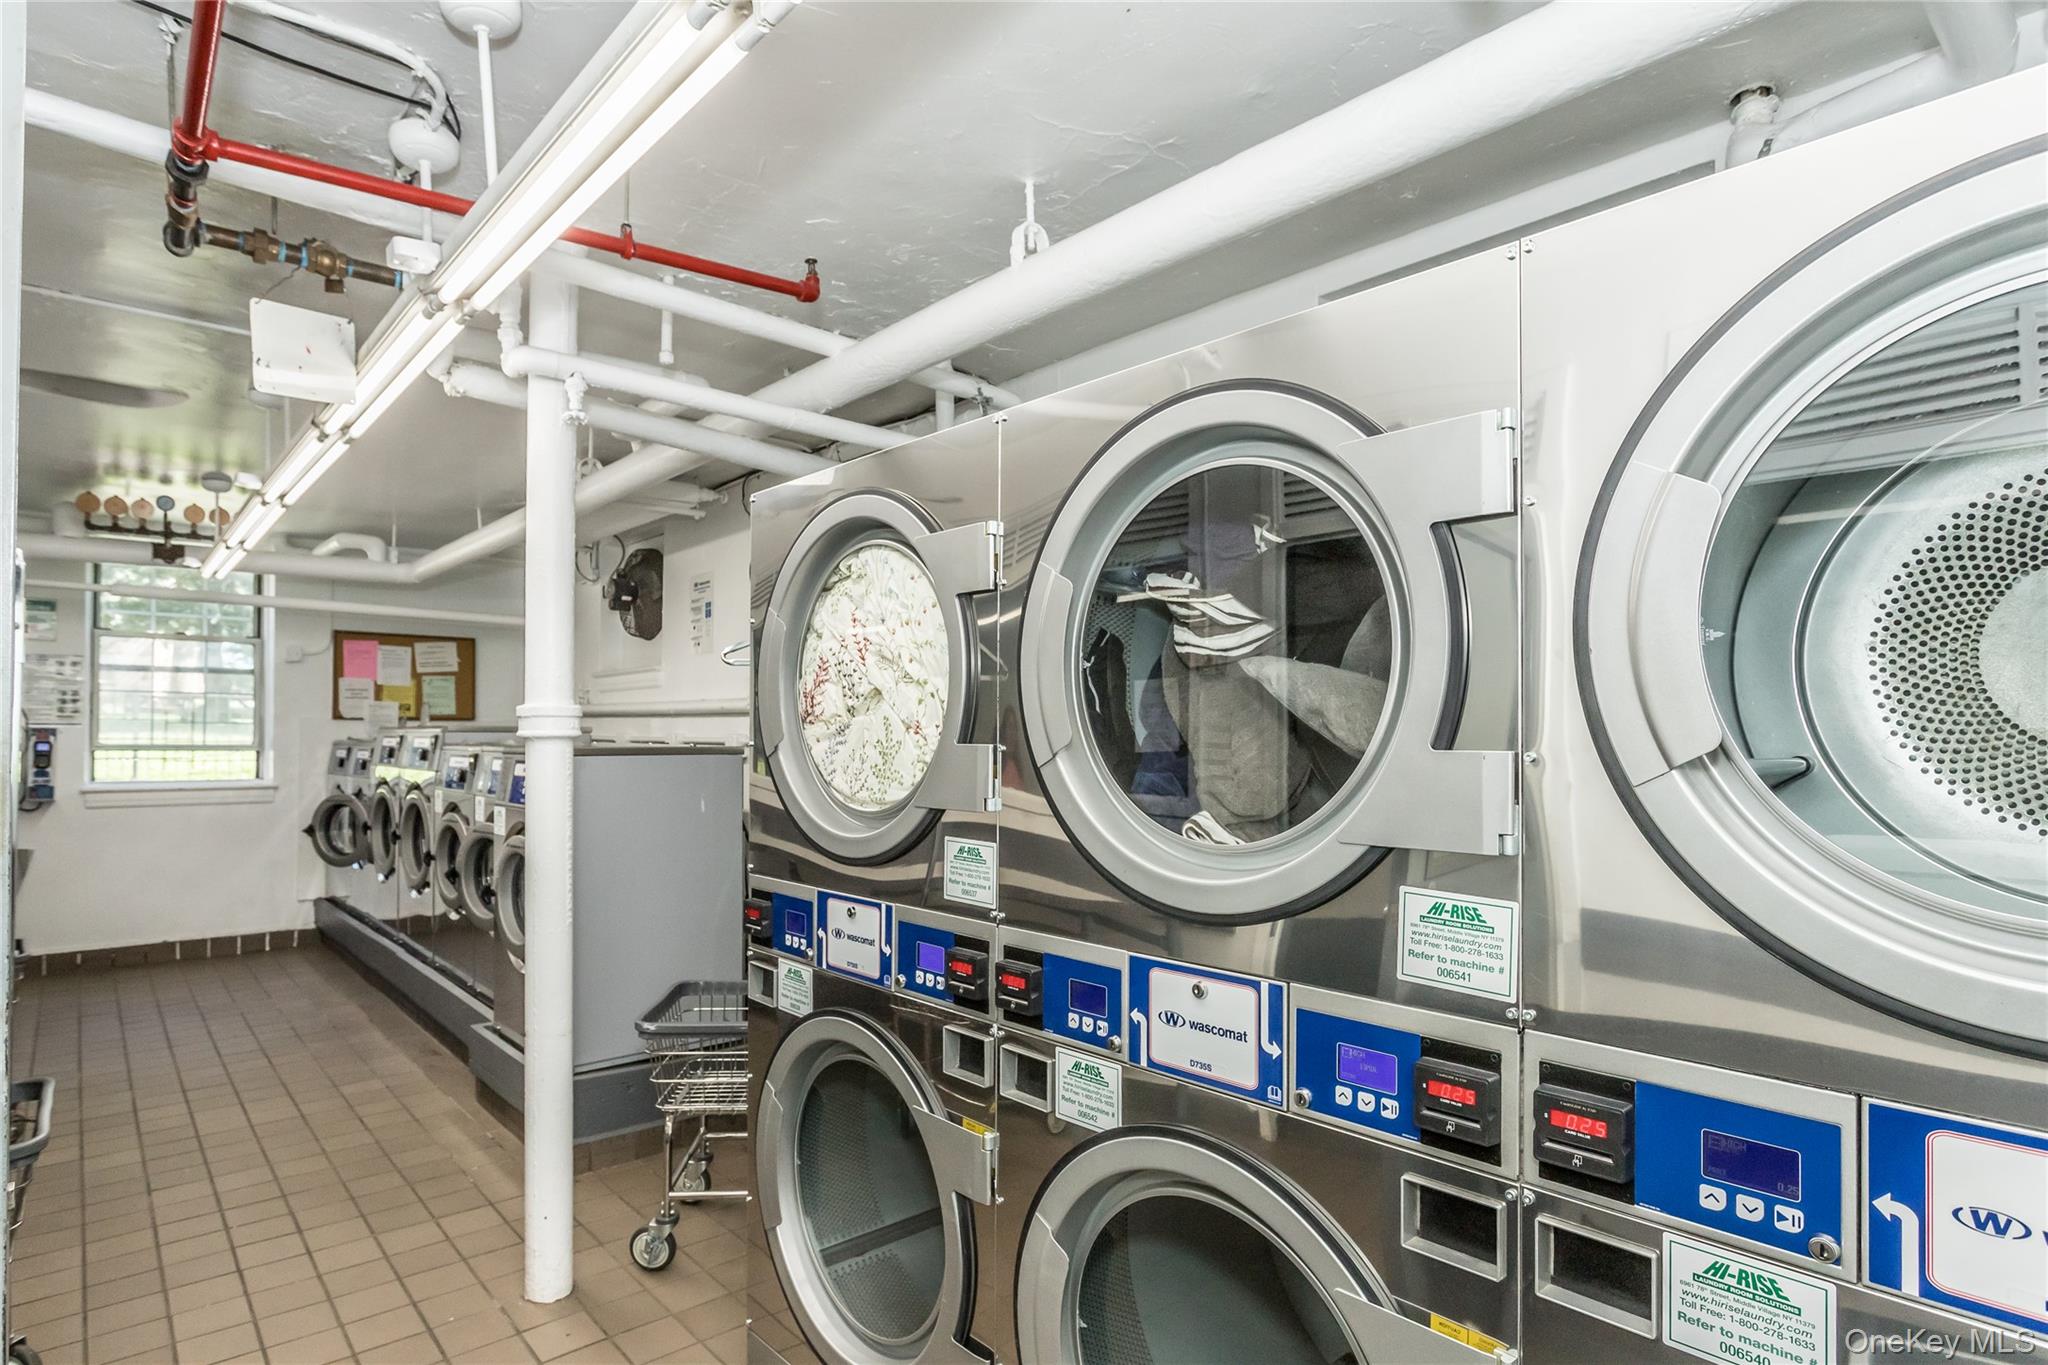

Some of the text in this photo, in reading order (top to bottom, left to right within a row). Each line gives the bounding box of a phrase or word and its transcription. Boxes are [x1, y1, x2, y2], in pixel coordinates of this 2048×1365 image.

[1427, 902, 1488, 924] HI-RISE
[846, 933, 876, 947] wascomat
[1411, 930, 1502, 950] www.hiriselaundry.com
[1424, 940, 1442, 949] Free:
[1444, 944, 1504, 960] 1-800-278-1633
[1408, 948, 1504, 974] Refer to machine #
[1436, 967, 1472, 982] 006541
[1188, 1020, 1248, 1042] wascomat
[1072, 1060, 1104, 1079] HI-RISE
[1190, 1060, 1212, 1072] D735S
[1777, 1182, 1800, 1196] 0.25
[1702, 1260, 1791, 1302] HI-RISE
[1694, 1274, 1799, 1314] LAUNDRY ROOM SOLUTIONS
[1680, 1297, 1816, 1351] Toll Free: 1-800-278-1633
[1682, 1288, 1812, 1338] www.hiriselaundry.com
[1733, 1296, 1755, 1308] Middle
[1758, 1304, 1780, 1318] Village
[1782, 1312, 1793, 1322] NY
[1795, 1318, 1816, 1330] 11379
[1677, 1311, 1715, 1332] Refer
[1719, 1325, 1734, 1340] to
[1738, 1332, 1804, 1364] machine
[1720, 1341, 1770, 1365] 006540
